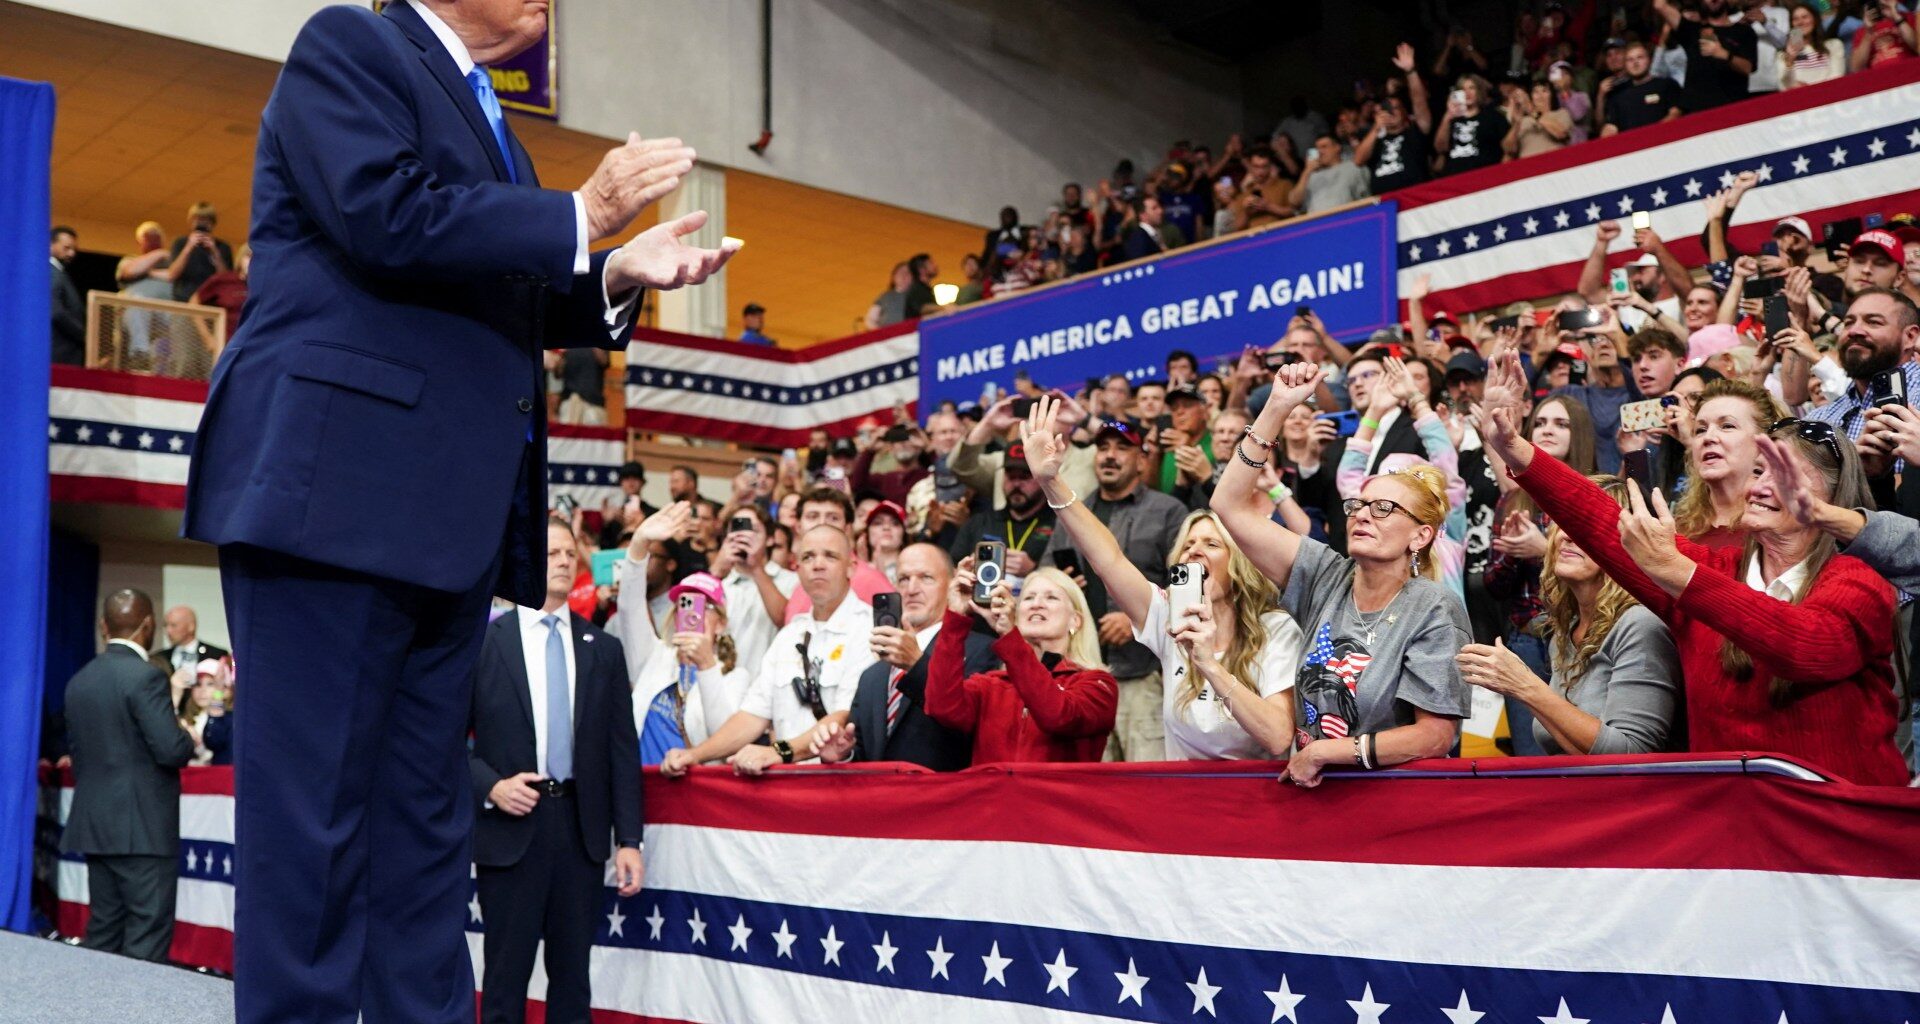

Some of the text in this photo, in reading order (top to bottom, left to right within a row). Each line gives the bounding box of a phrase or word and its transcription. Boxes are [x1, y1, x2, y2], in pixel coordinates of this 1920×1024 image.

[937, 262, 1364, 382] MAKE AMERICA GREAT AGAIN!
